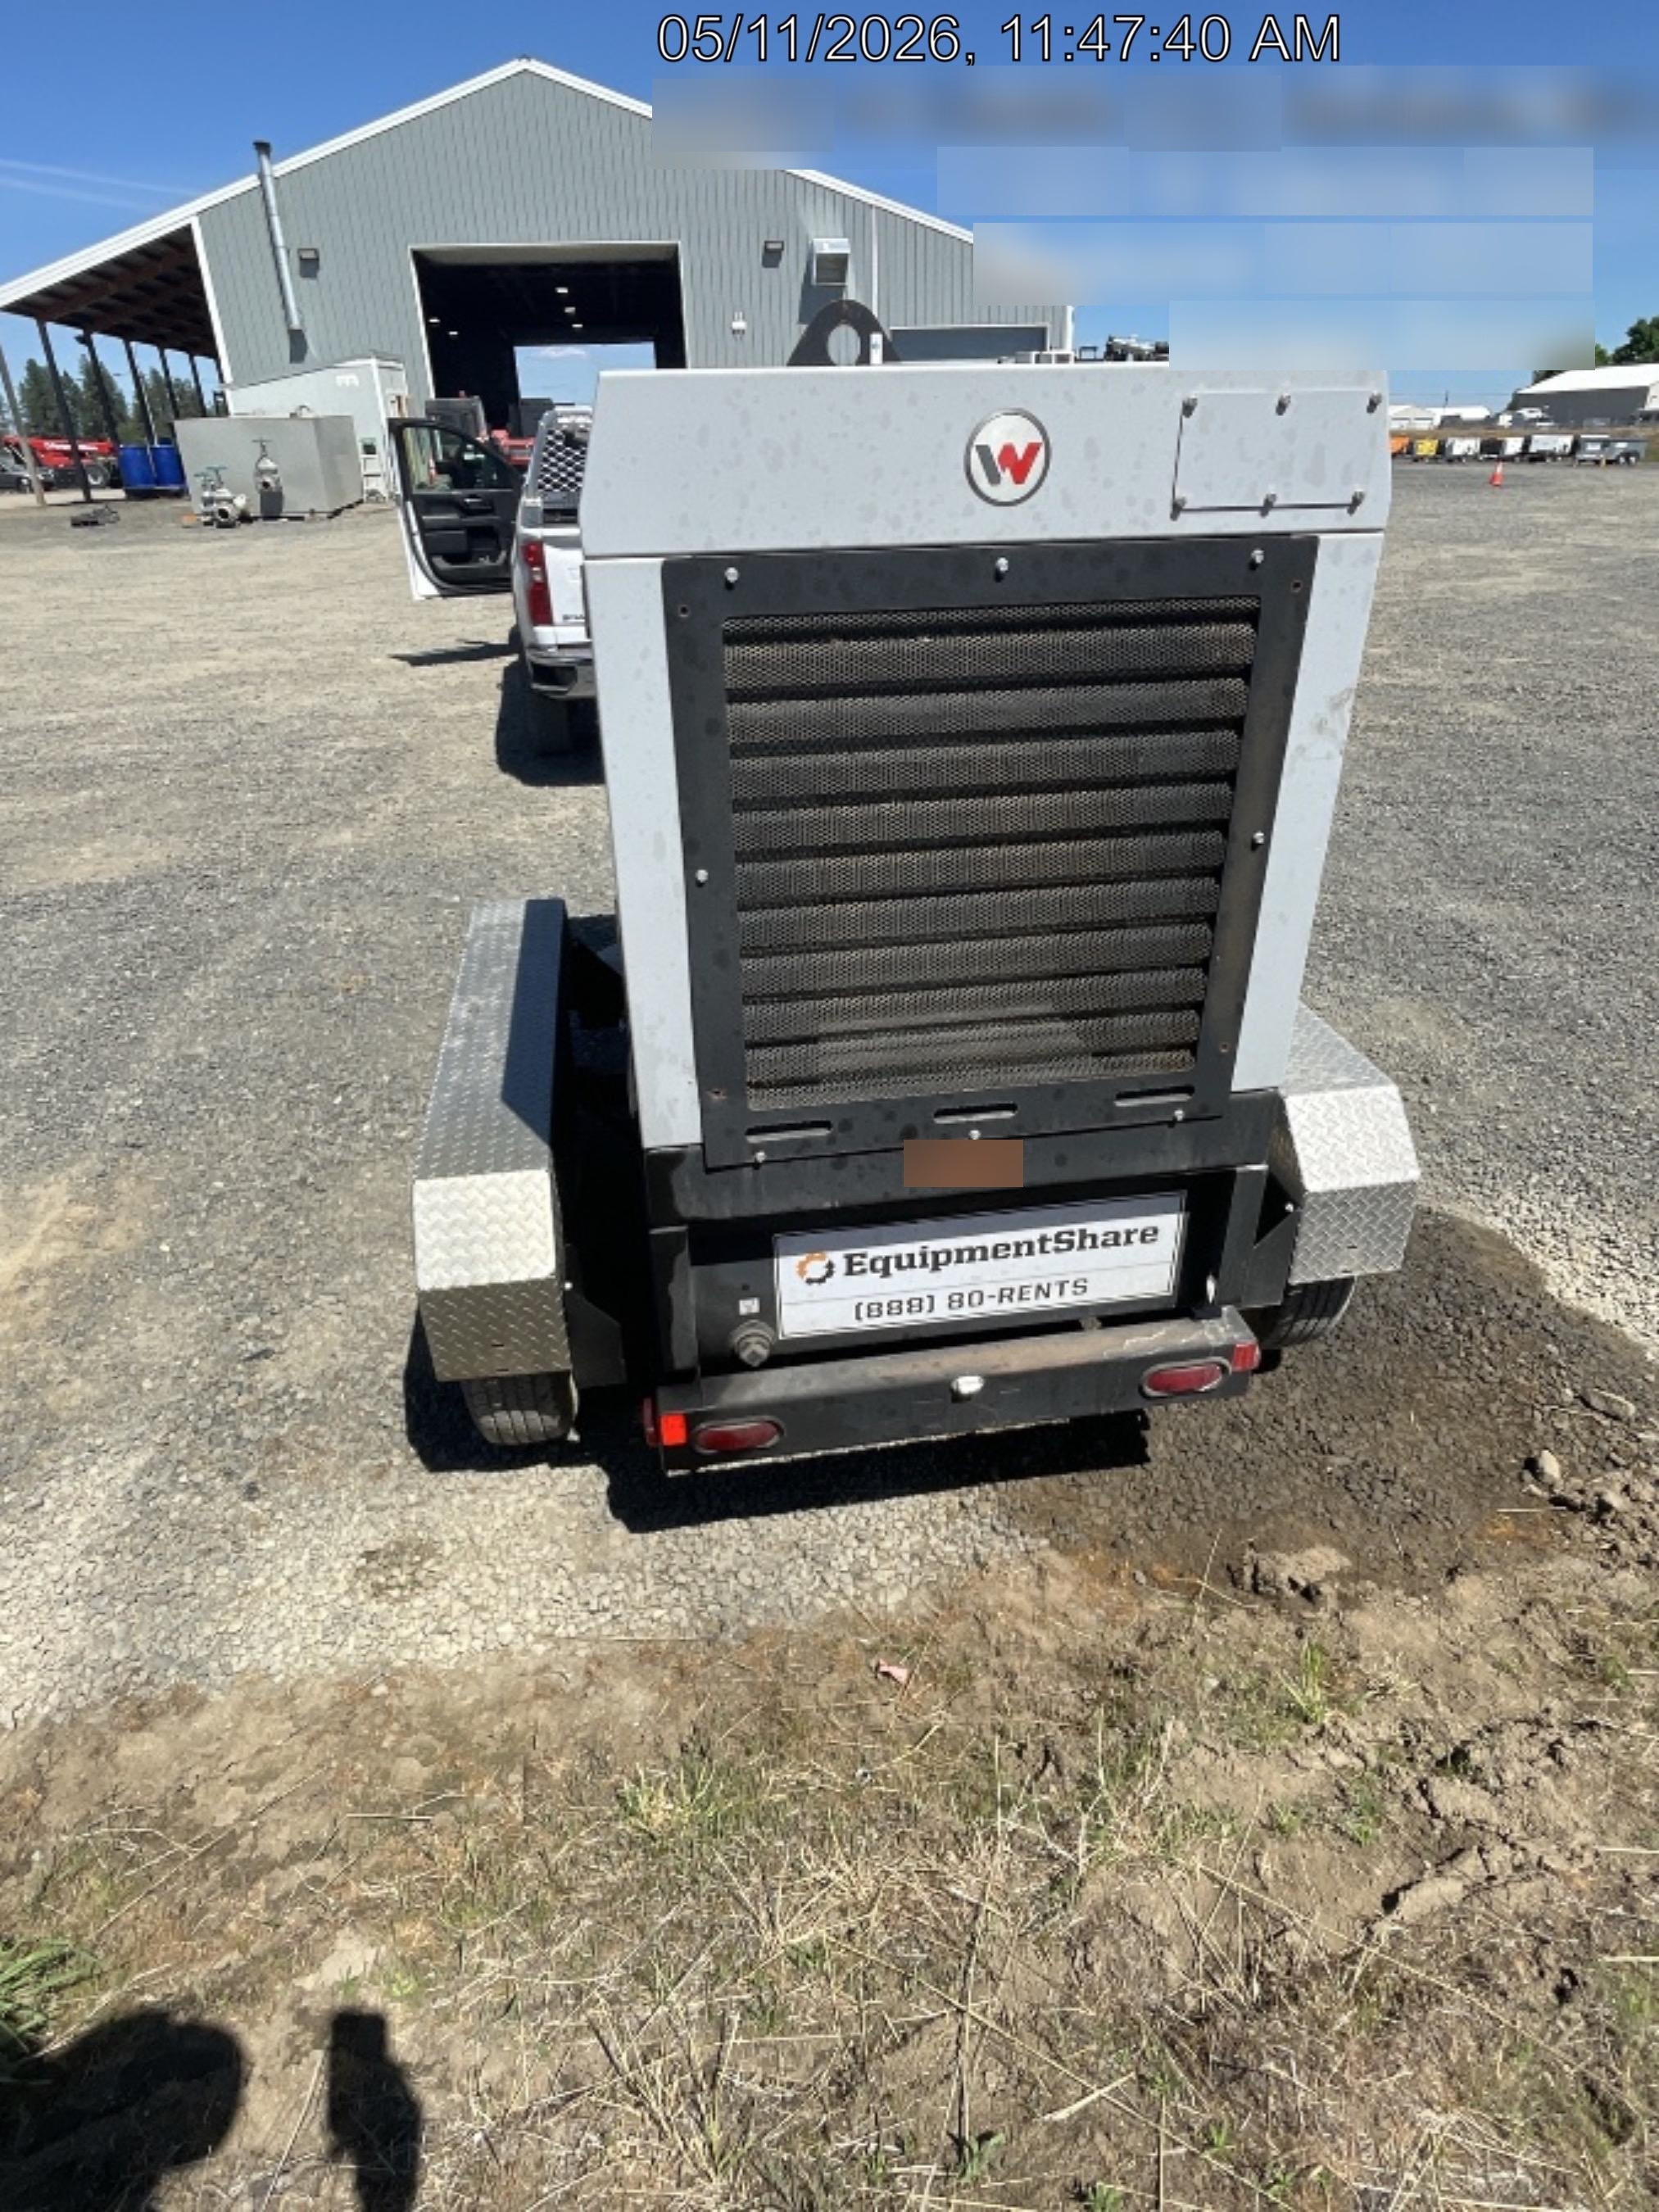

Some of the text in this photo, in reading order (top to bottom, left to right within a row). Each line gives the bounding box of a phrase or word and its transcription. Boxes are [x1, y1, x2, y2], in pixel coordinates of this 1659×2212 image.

[844, 1226, 1159, 1277] EquipmentShare
[854, 1278, 1089, 1321] (888) 80-RENTS
